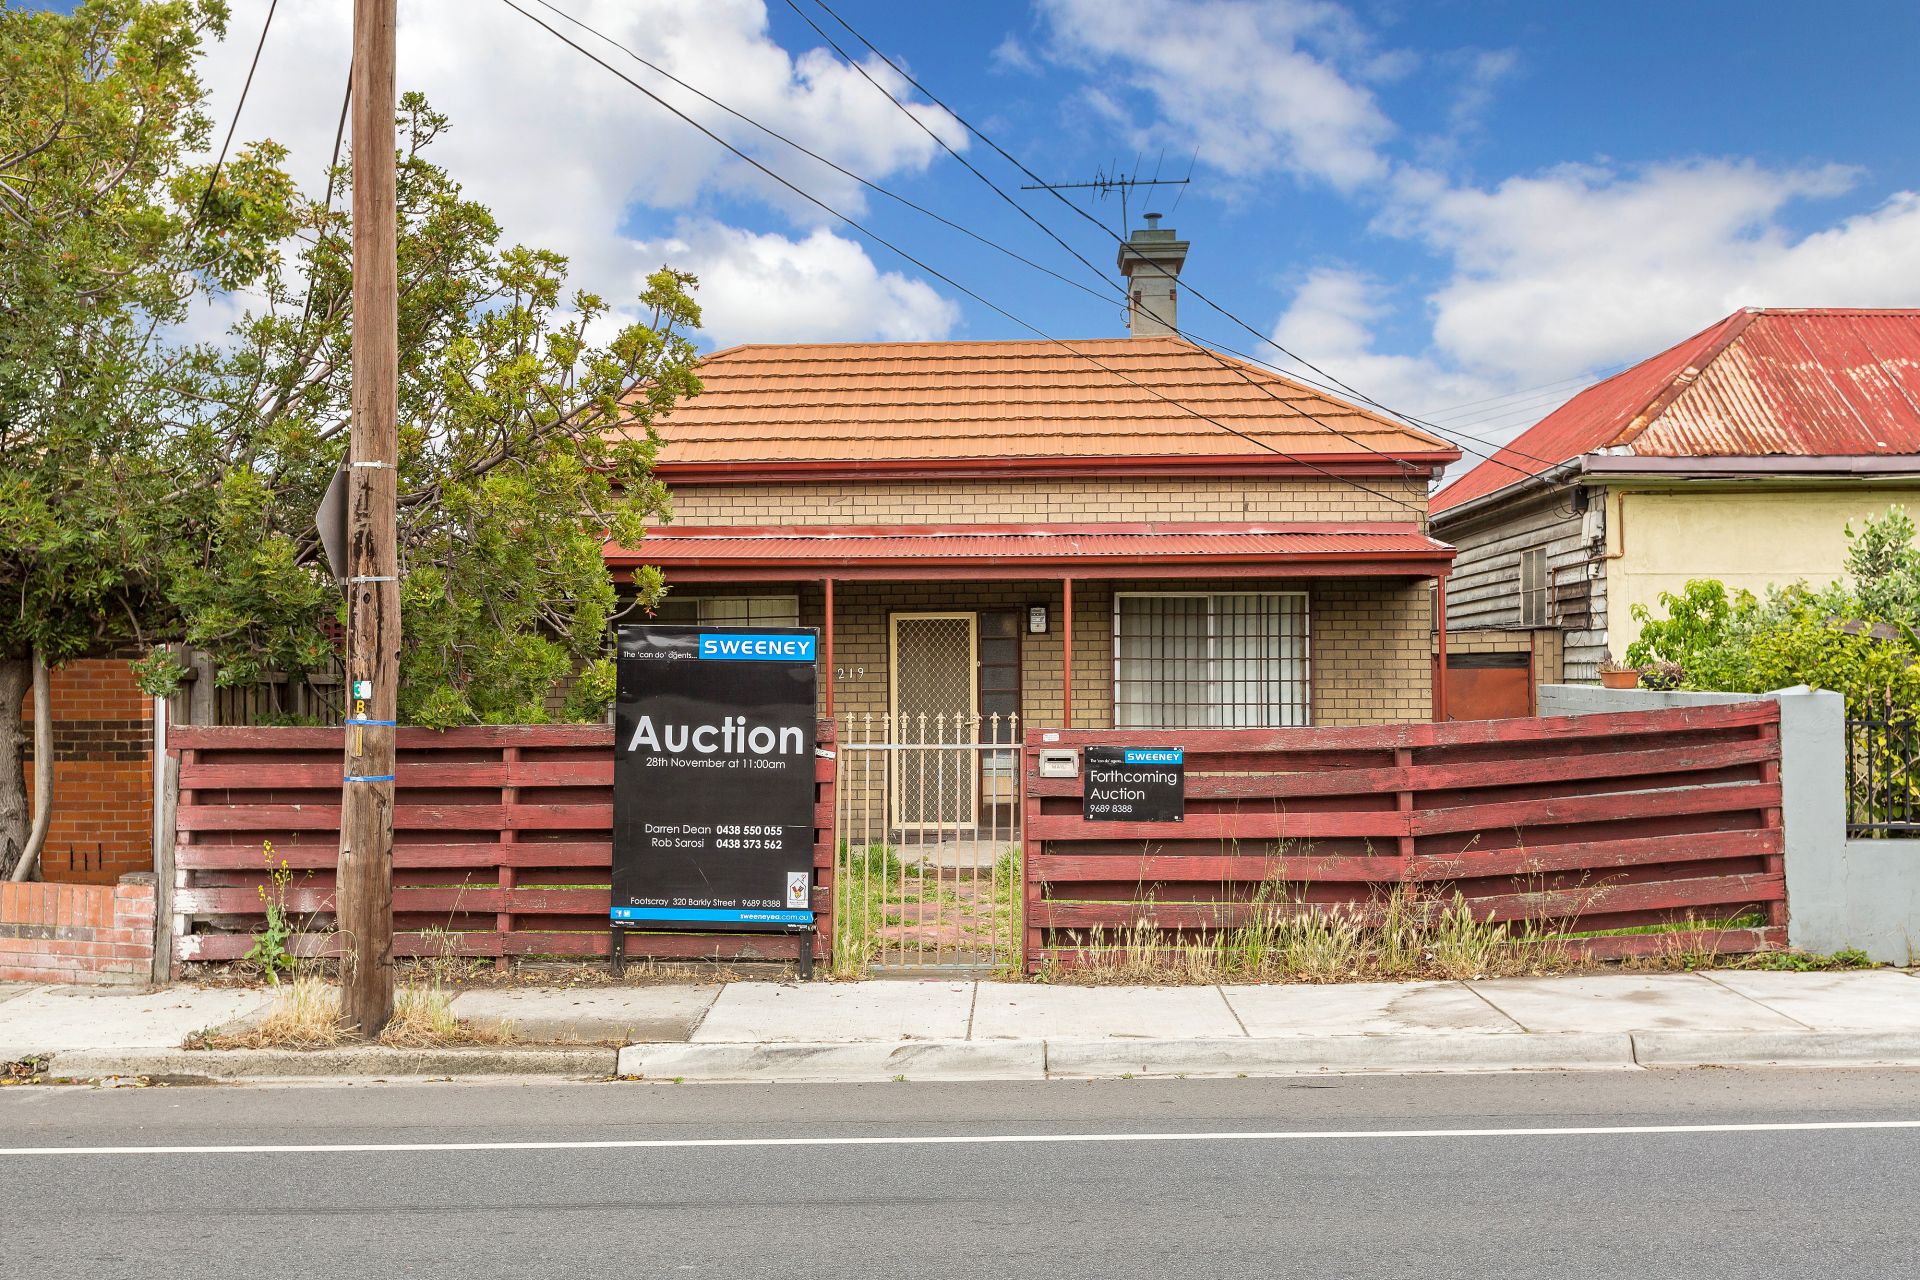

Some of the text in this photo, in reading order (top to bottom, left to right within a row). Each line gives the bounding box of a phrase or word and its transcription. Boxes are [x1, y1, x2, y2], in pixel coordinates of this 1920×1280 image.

[704, 640, 810, 655] SWEENEY
[623, 651, 636, 659] The
[837, 667, 864, 679] 219
[356, 700, 365, 713] B
[627, 715, 804, 754] Auction
[646, 757, 786, 769] 28th November at 11:00am
[1127, 753, 1180, 761] SWEENEY
[1090, 770, 1177, 785] Forthcoming
[1090, 787, 1145, 800] Auction
[1090, 804, 1133, 813] 9689 8388
[645, 824, 783, 836] Darren Dean 0438 550 055
[651, 837, 783, 849] Rob Sarosi 0438 373 562
[630, 897, 669, 907] Footscray
[672, 898, 687, 906] 320
[688, 898, 712, 908] Barkly
[713, 898, 736, 907] Street
[742, 899, 761, 908] 9689
[762, 899, 781, 908] 8388
[740, 913, 809, 921] sweeneyea.com.au
